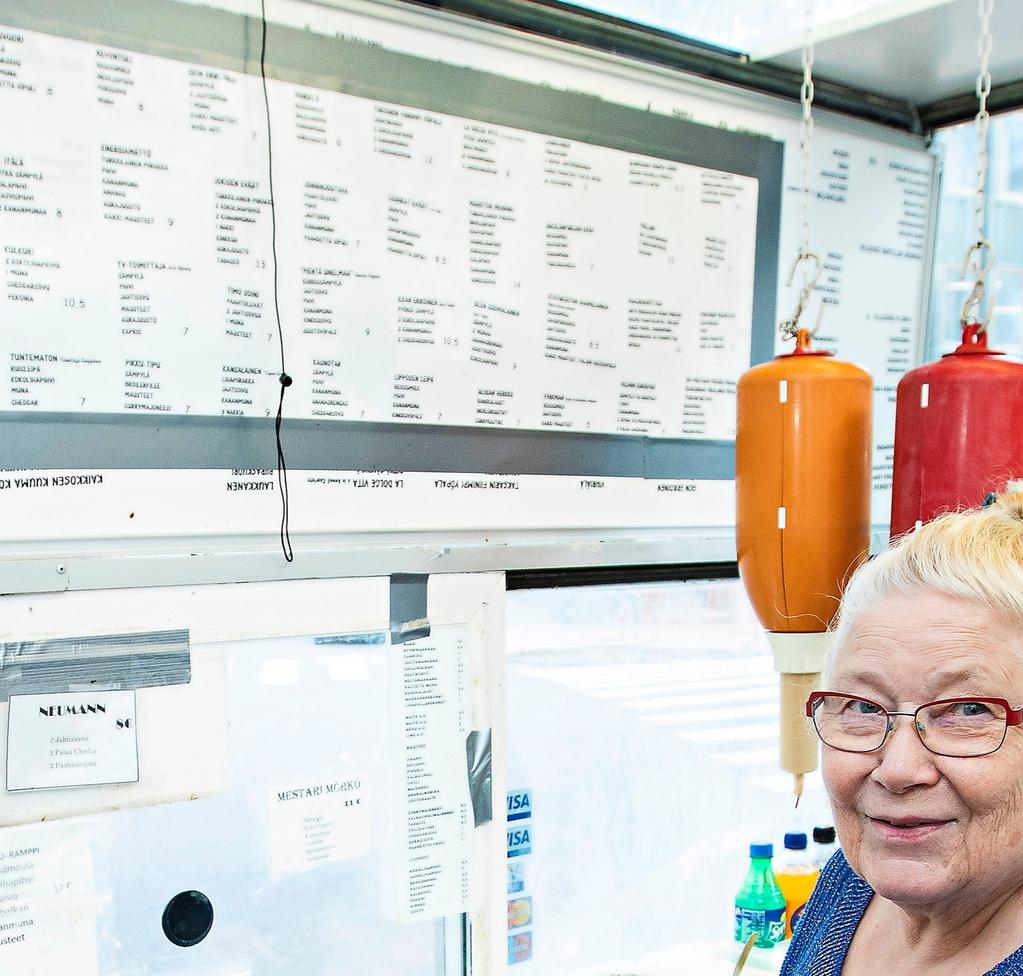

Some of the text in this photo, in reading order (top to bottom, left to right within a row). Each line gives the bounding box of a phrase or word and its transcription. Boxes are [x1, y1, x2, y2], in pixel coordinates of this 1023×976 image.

[183, 327, 189, 336] 7
[11, 353, 58, 362] TUNTEMATON
[80, 397, 86, 406] 7
[185, 404, 190, 413] 7
[15, 477, 49, 488] KUUMA
[52, 474, 103, 487] KAIKKOSEN
[226, 481, 274, 491] LAUKKANEN
[353, 479, 403, 488] LA DOLCE VITA
[39, 703, 106, 717] NEUMANN
[116, 718, 132, 729] 8€
[277, 779, 360, 802] MESTARI MÖRKÖ
[507, 793, 529, 810] ISA
[507, 829, 530, 847] ISA
